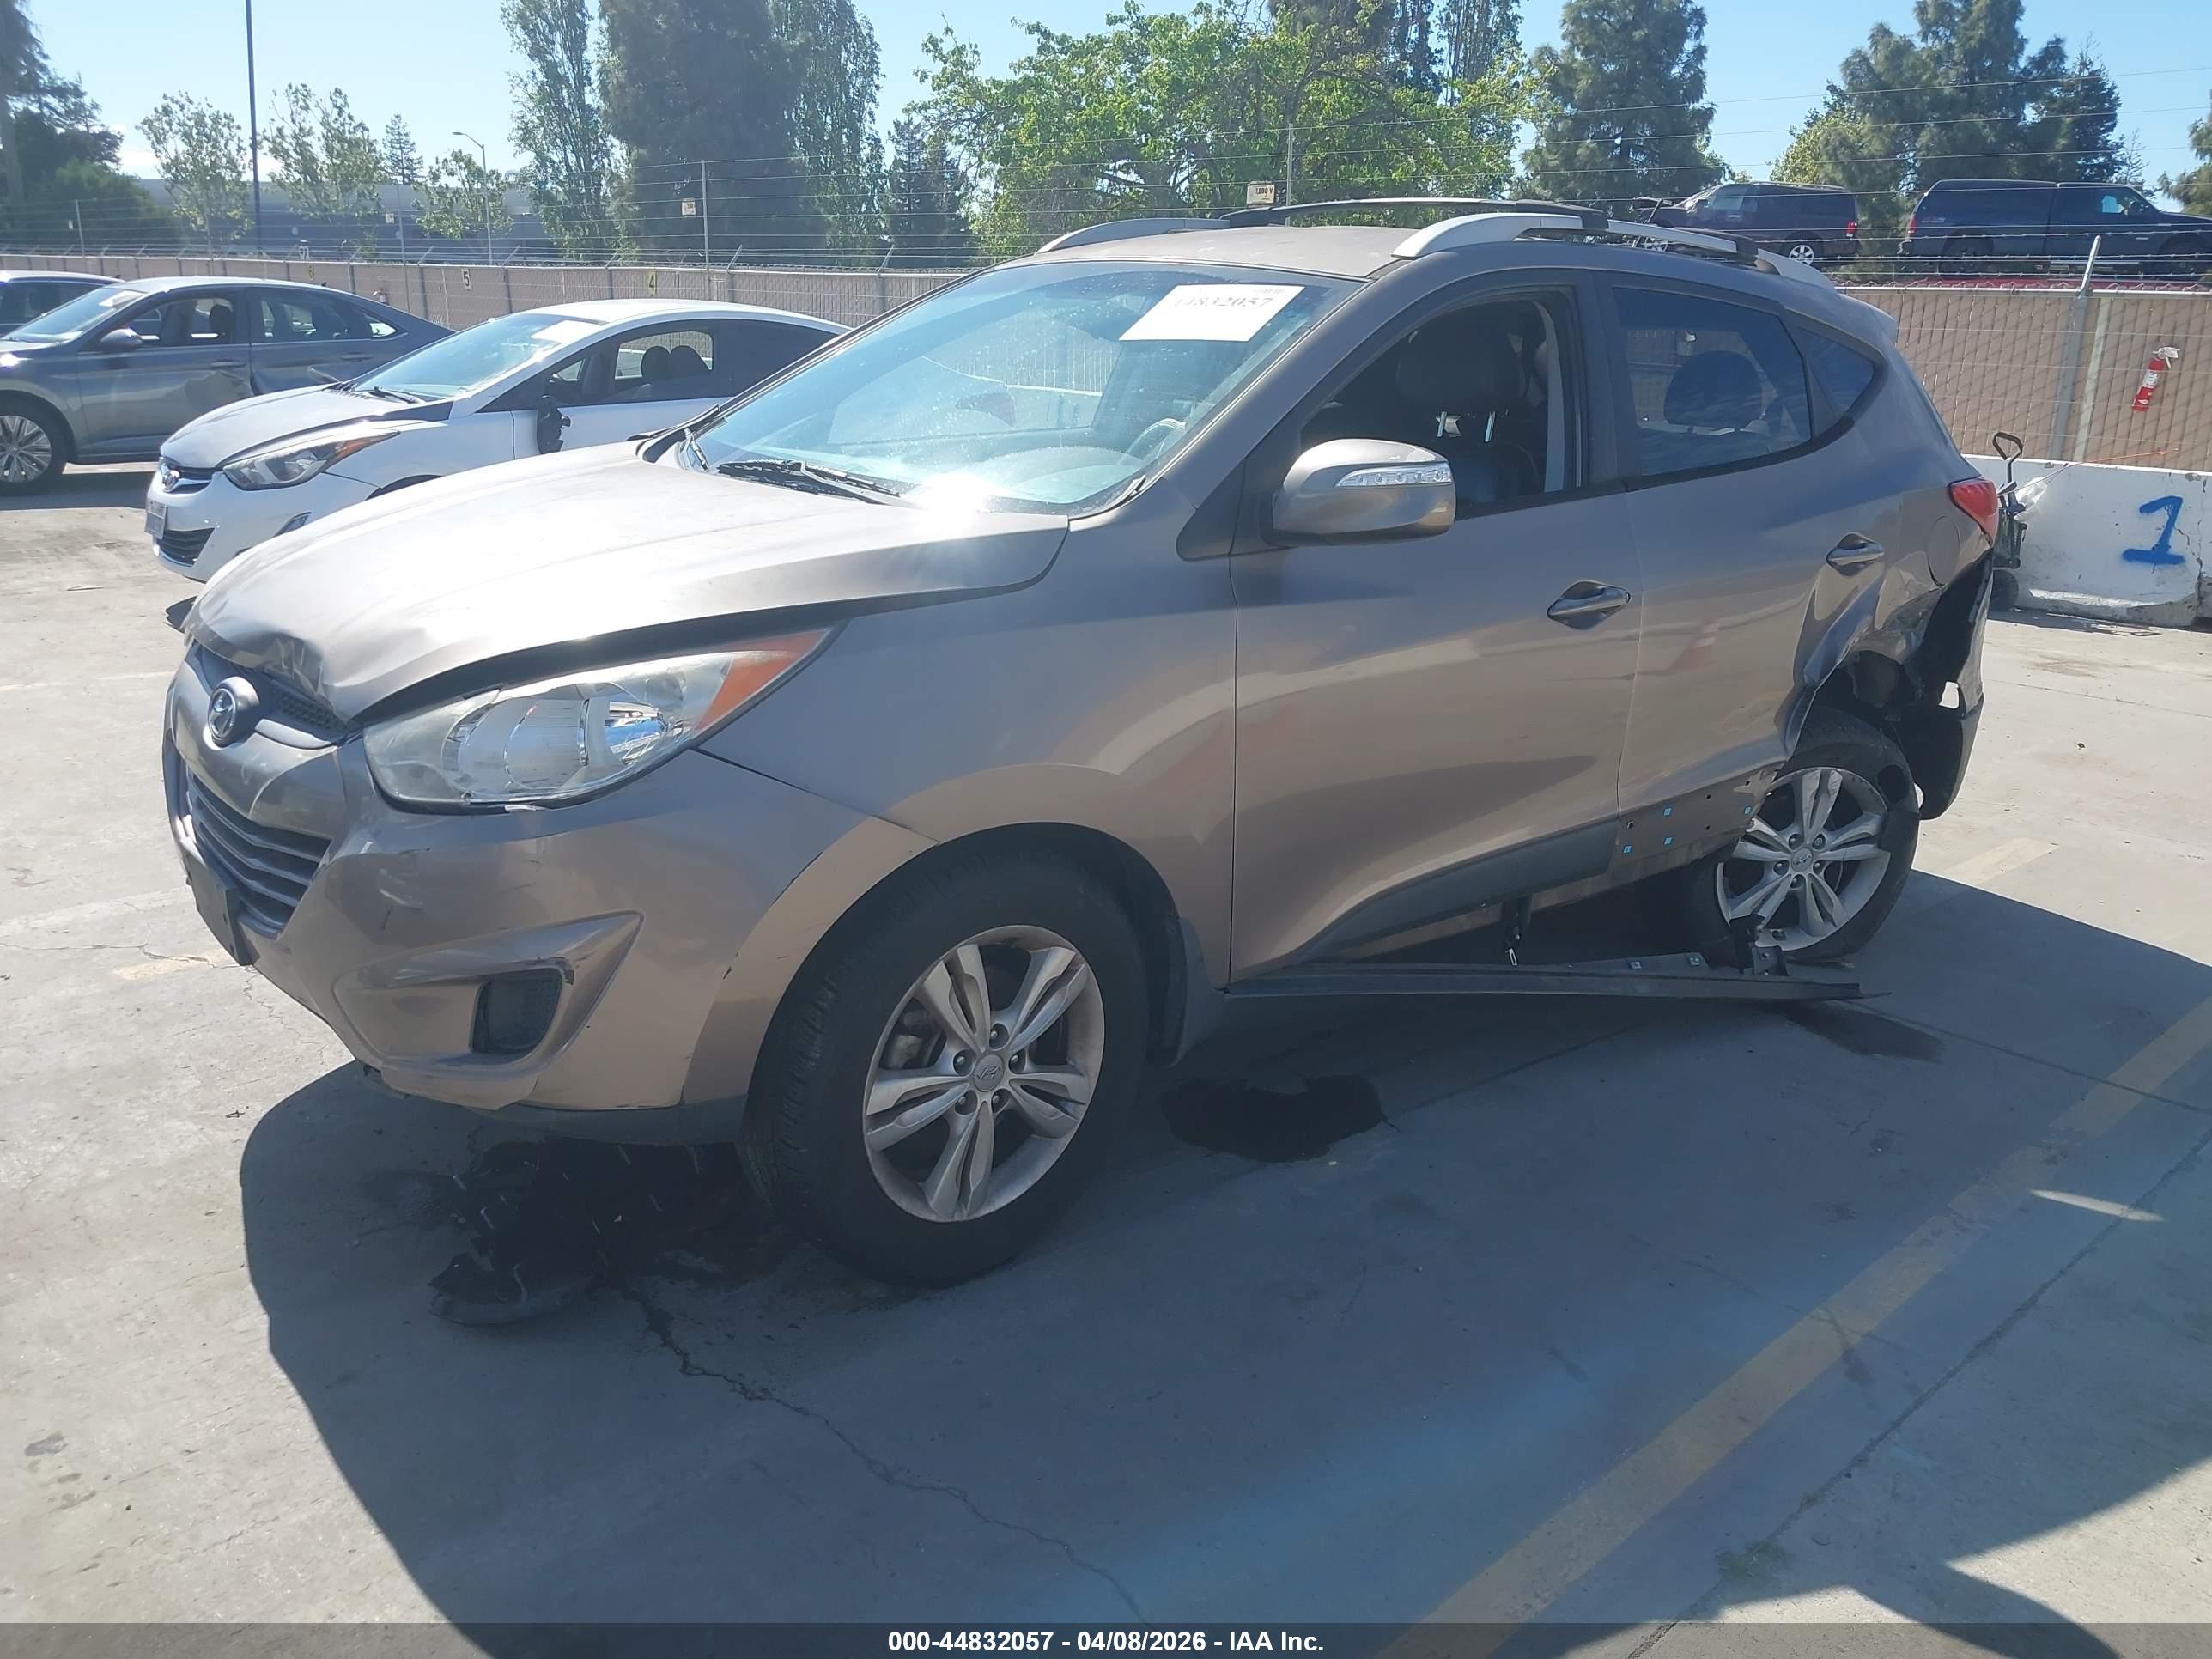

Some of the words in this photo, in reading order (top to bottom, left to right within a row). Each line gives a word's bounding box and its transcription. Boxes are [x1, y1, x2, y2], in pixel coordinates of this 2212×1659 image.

[463, 270, 470, 287] 5
[649, 272, 654, 292] 4
[2122, 495, 2186, 565] 1
